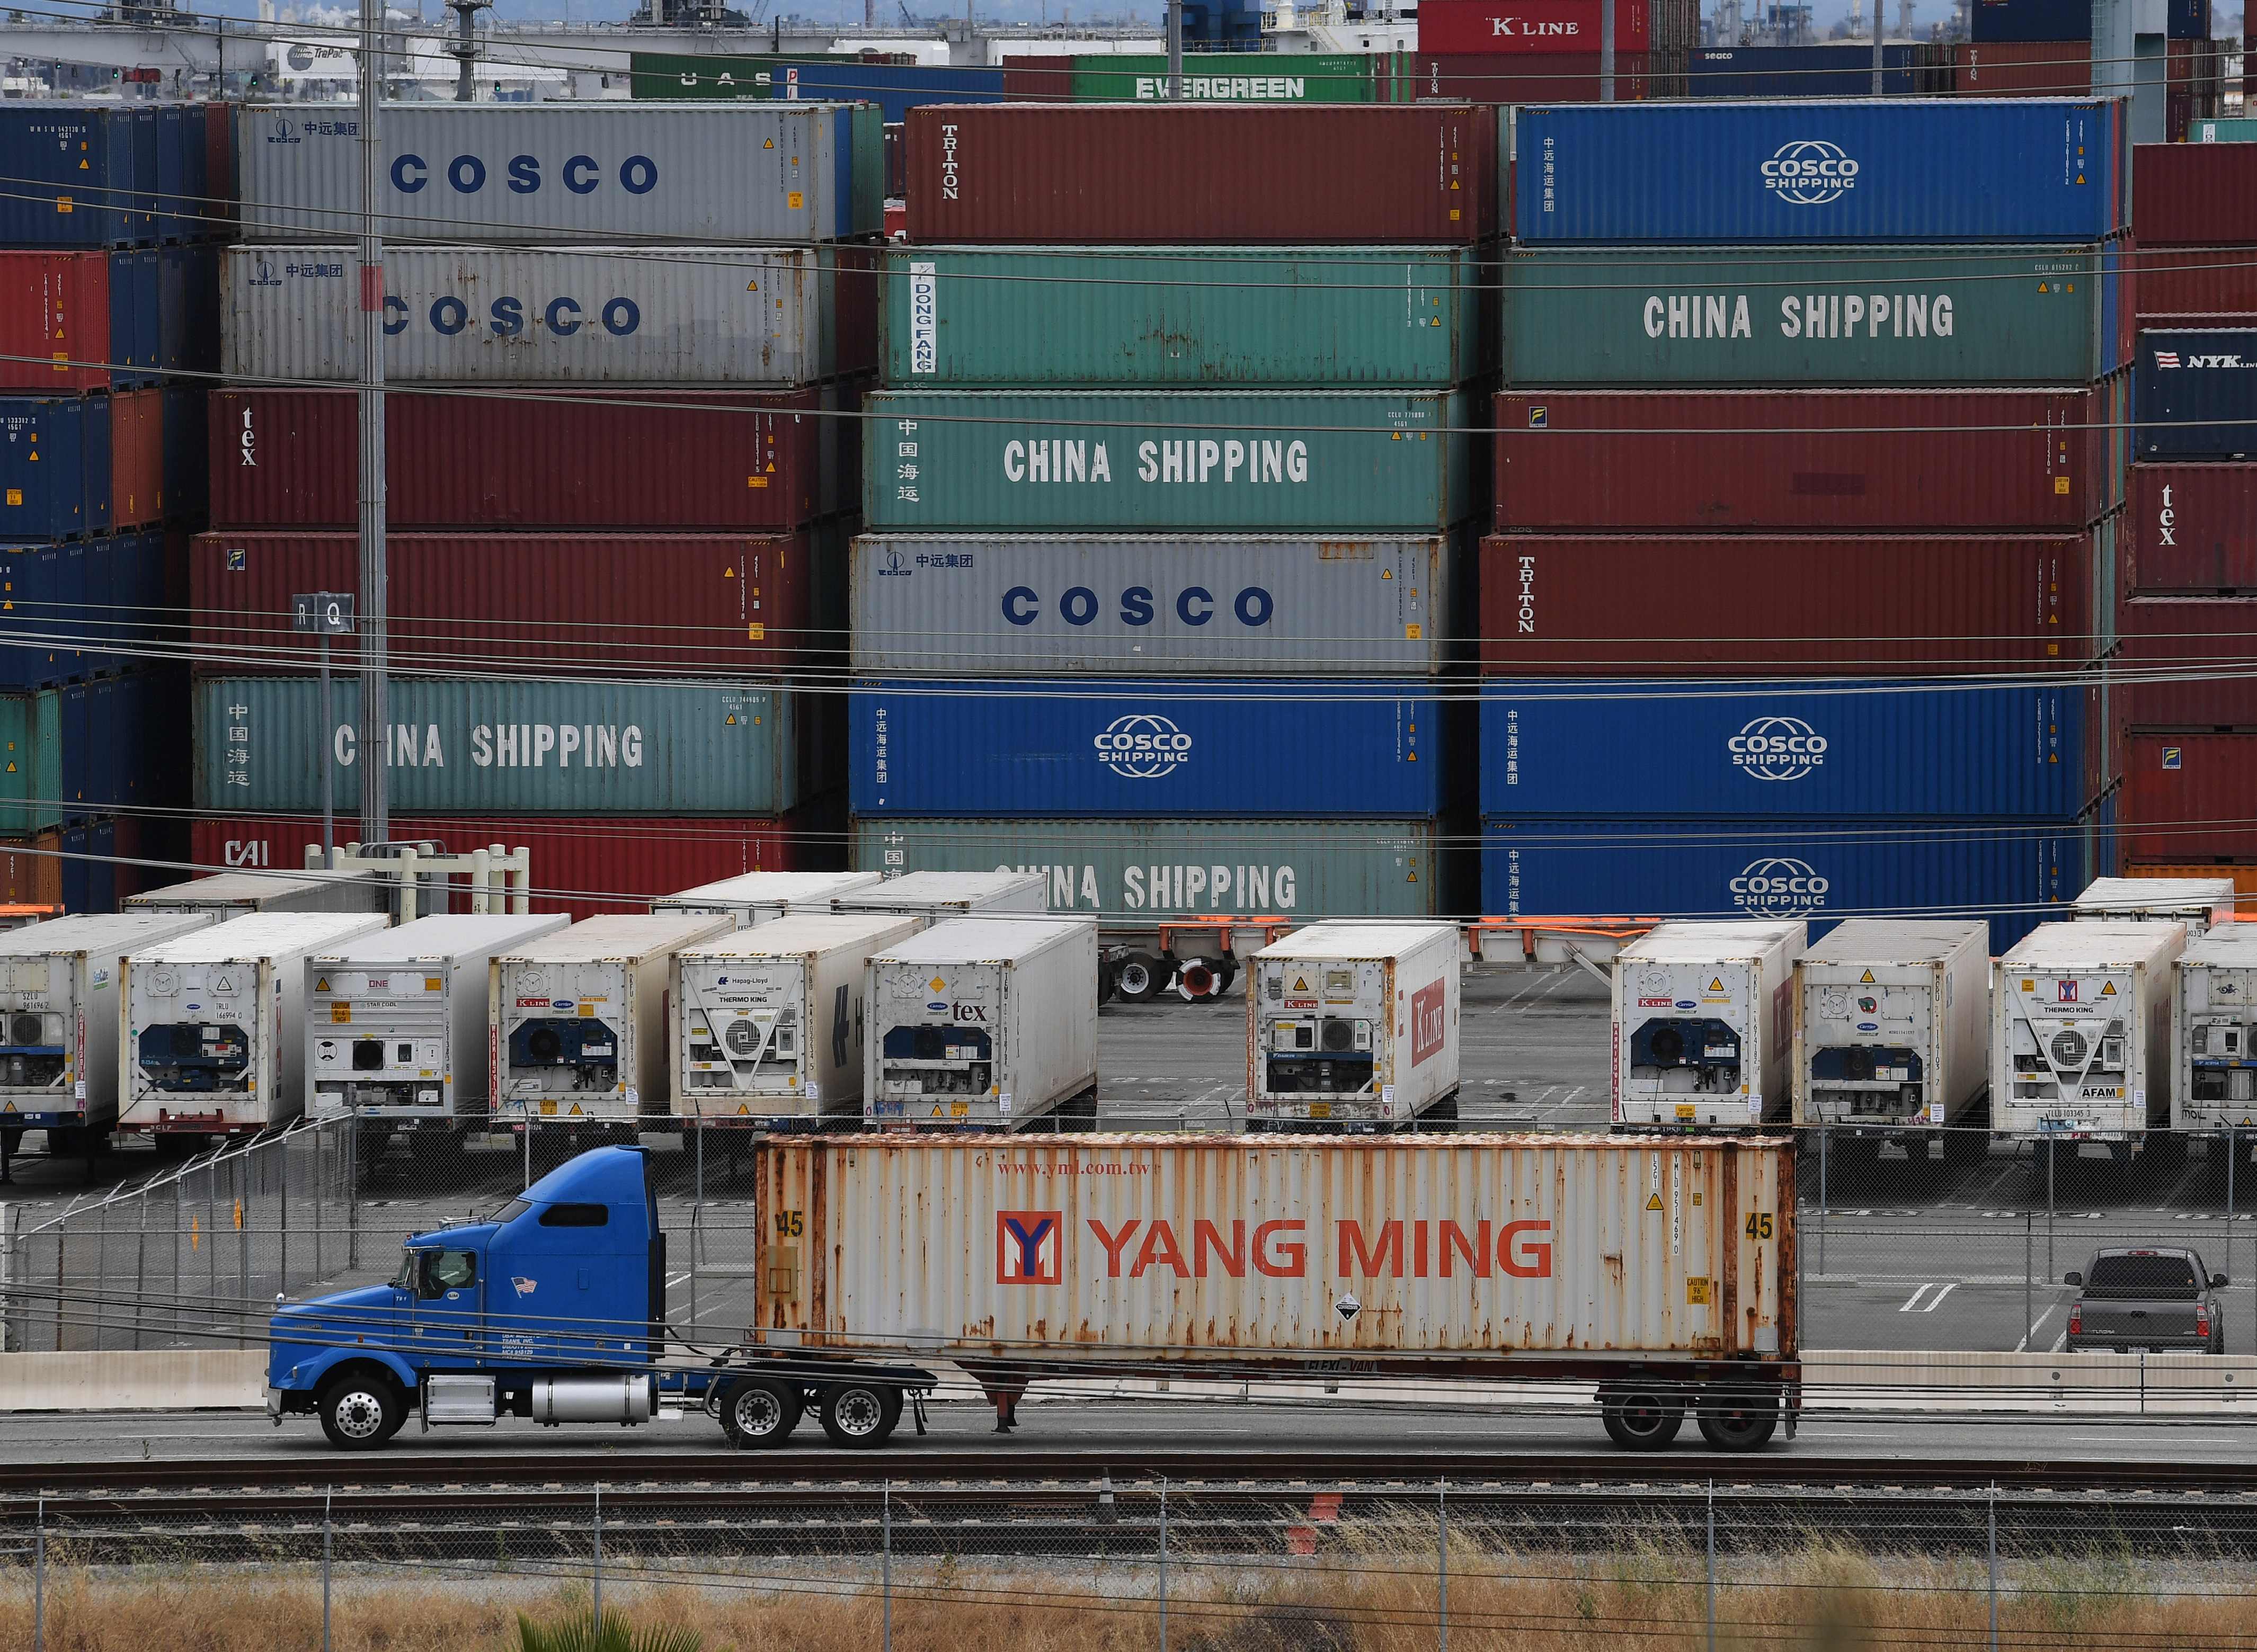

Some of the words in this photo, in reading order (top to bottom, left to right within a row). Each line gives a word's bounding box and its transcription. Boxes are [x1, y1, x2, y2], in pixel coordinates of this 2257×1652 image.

[1523, 22, 1579, 35] LINE
[1136, 77, 1304, 99] EVERGREEN
[304, 121, 360, 136] 中远集团
[390, 154, 658, 194] COSCO
[942, 124, 958, 200] TRITON
[1543, 137, 1554, 212] 中远海运集团
[1761, 159, 1859, 176] COSCO
[1765, 178, 1855, 189] SHIPPING
[285, 263, 343, 278] 中远集团
[383, 296, 641, 336] COSCO
[916, 284, 931, 325] DONG
[1643, 294, 1752, 340] CHINA
[1780, 293, 1953, 339] SHIPPING
[916, 329, 931, 371] FANG
[2187, 355, 2241, 368] NYK
[241, 406, 257, 467] tex
[898, 420, 920, 502] 中国海运
[1003, 440, 1111, 483] CHINA
[1138, 440, 1308, 483] SHIPPING
[2158, 484, 2176, 546] tex
[916, 553, 973, 568] 中远集团
[1001, 585, 1274, 626] COSCO
[1518, 556, 1535, 633] TRITON
[299, 604, 306, 626] R
[327, 602, 341, 626] Q
[227, 703, 250, 787] 中国海运
[334, 724, 444, 767] CINA
[472, 724, 643, 767] SHIPPING
[876, 708, 887, 783] 中远海运集团
[1094, 734, 1192, 751] COSCO
[1507, 709, 1518, 785] 中远海运集团
[1728, 736, 1827, 753] COSCO
[1099, 752, 1188, 763] SHIPPING
[1732, 754, 1824, 765] SHIPPING
[225, 840, 268, 867] CAI
[1124, 865, 1296, 908] SHIPPING
[1508, 849, 1520, 916] 中远海运集
[1729, 877, 1829, 894] COSCO
[1734, 895, 1825, 906] SHIPPING
[23, 1001, 43, 1010] 961696
[952, 1000, 988, 1022] tex
[1425, 1005, 1442, 1048] LINE
[2082, 1088, 2116, 1097] AFAM
[2064, 1109, 2084, 1118] 103345
[2182, 1109, 2207, 1120] MOL
[998, 1162, 1150, 1180] www.yml.com.tw
[777, 1211, 804, 1237] 45
[1746, 1212, 1773, 1239] 45
[1086, 1220, 1305, 1278] YANG
[1335, 1220, 1551, 1278] MING
[1687, 1278, 1709, 1287] CAUTION
[1349, 1361, 1374, 1371] VAN
